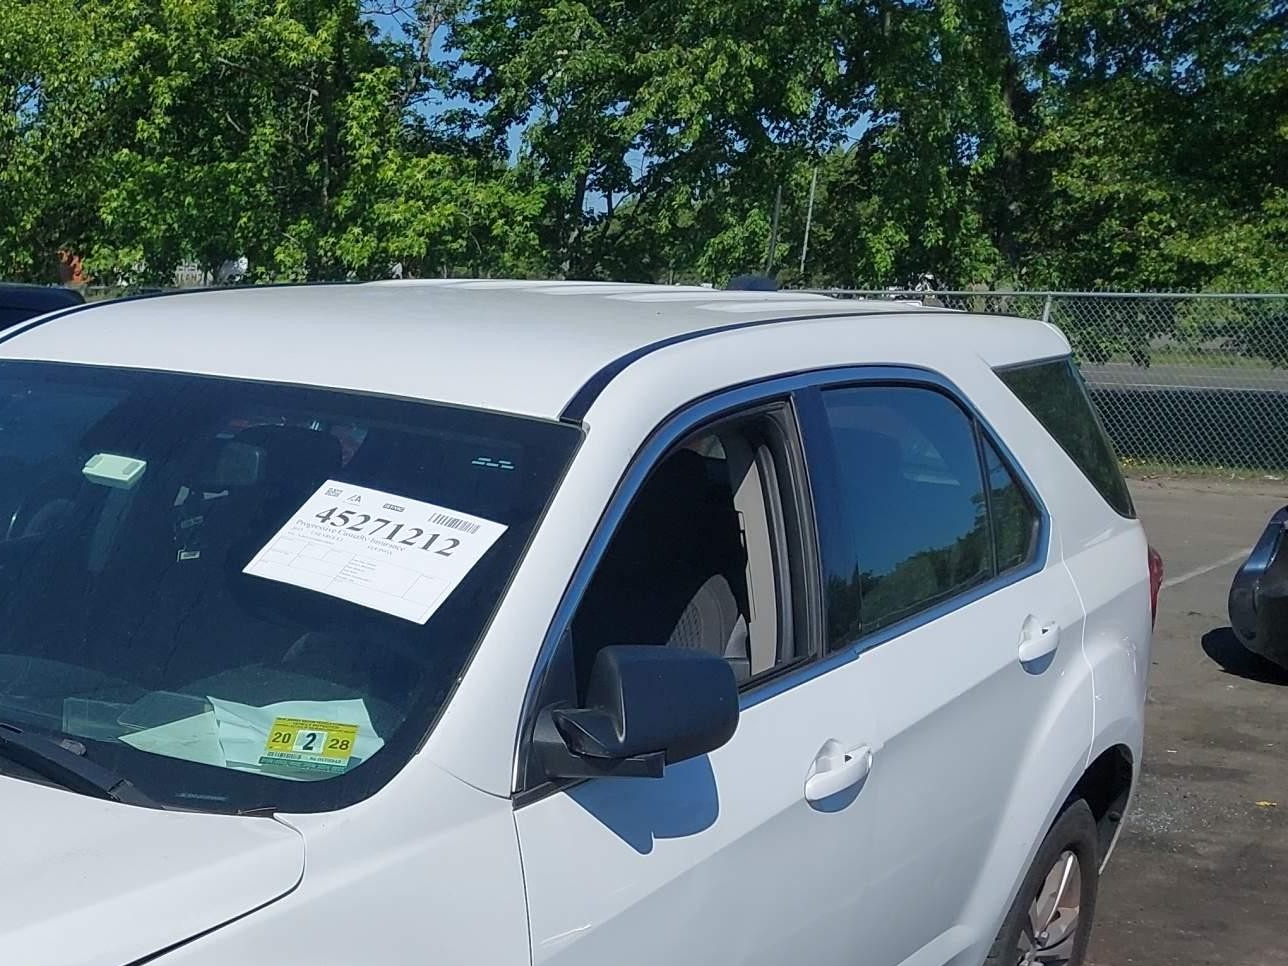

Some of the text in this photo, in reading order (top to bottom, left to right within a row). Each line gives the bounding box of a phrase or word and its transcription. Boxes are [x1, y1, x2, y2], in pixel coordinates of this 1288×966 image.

[295, 519, 337, 534] Progressive
[338, 529, 368, 542] Casualty
[369, 537, 406, 552] Insurance
[315, 506, 461, 557] 45271212
[272, 732, 350, 751] 20 2 28
